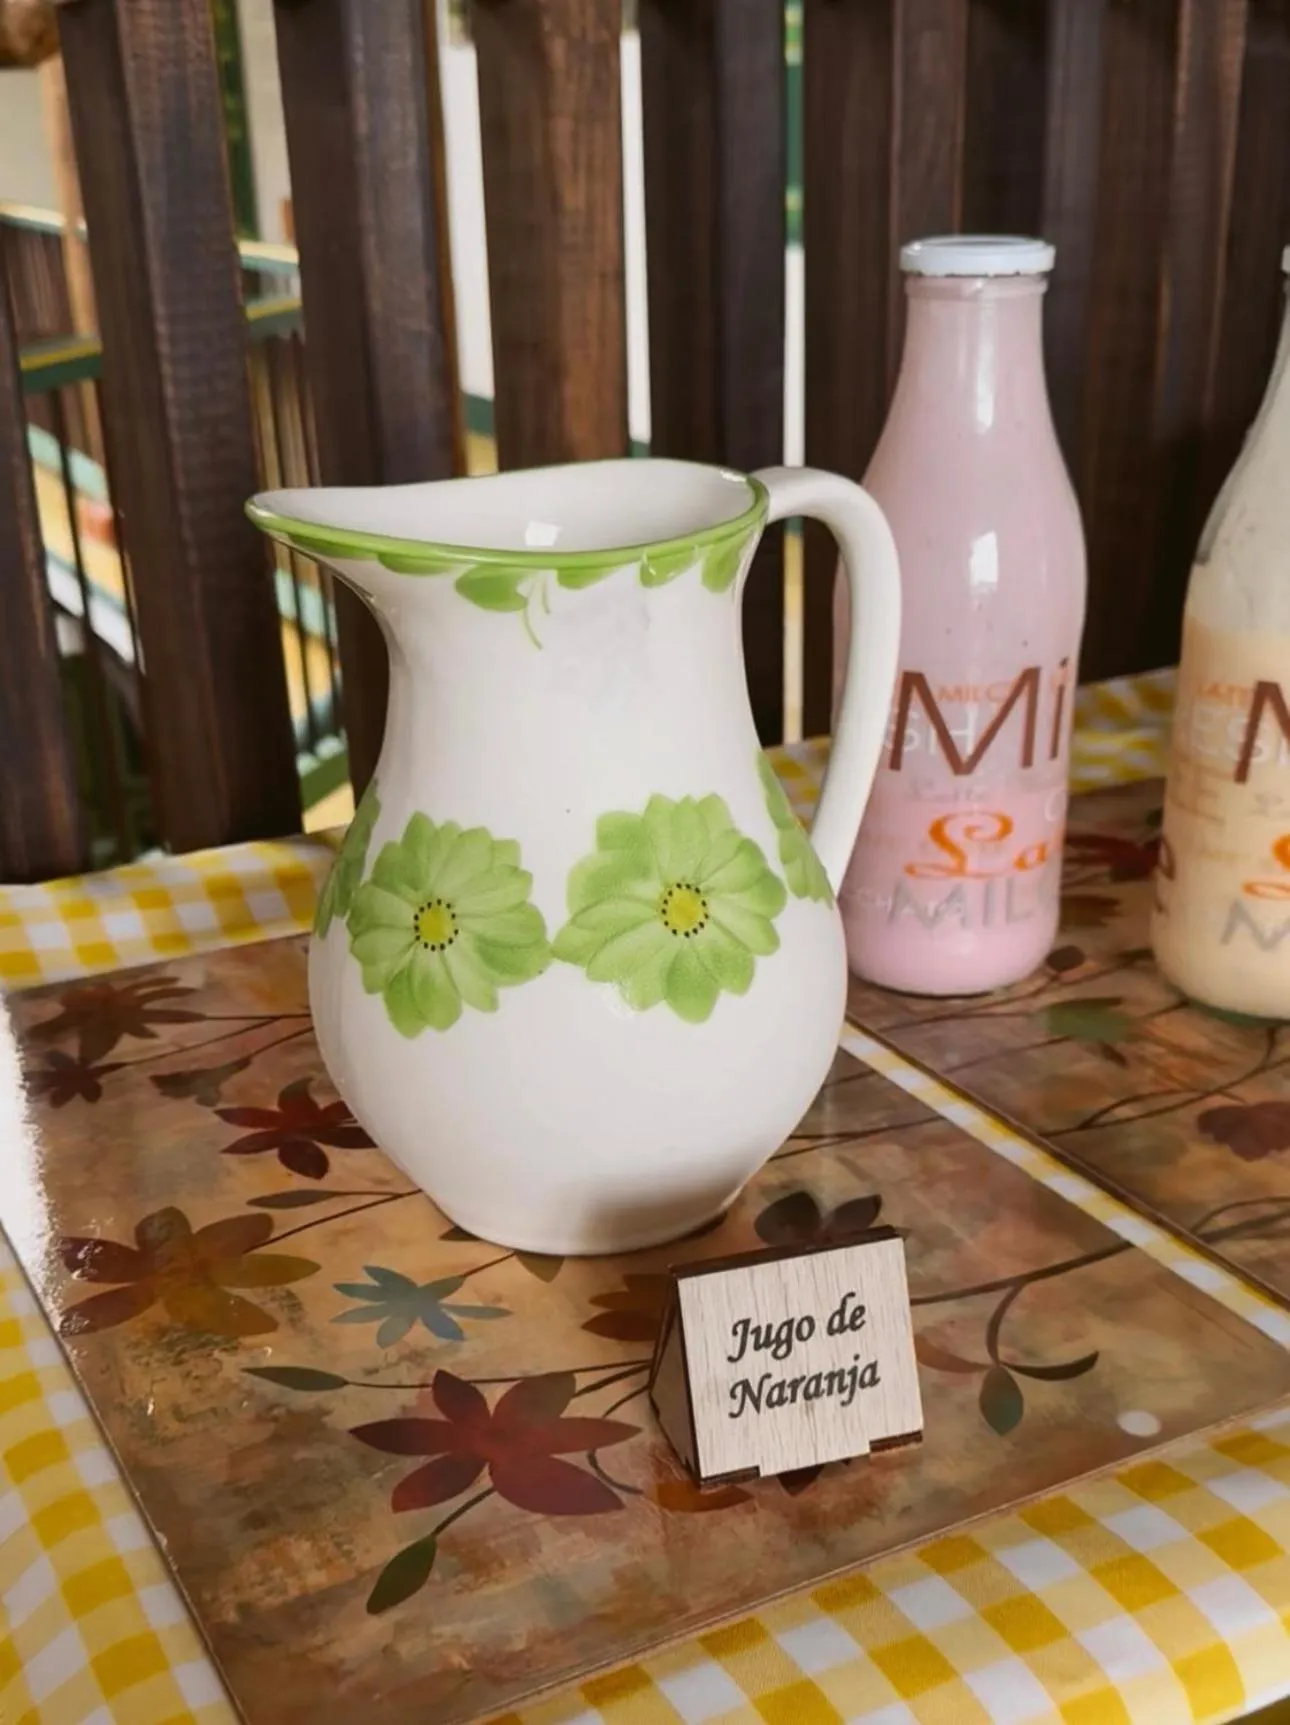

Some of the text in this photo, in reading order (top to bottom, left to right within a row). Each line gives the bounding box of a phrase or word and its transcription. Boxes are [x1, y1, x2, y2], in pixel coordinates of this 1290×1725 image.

[727, 1291, 866, 1363] Jugo de
[728, 1353, 881, 1419] Naranja
